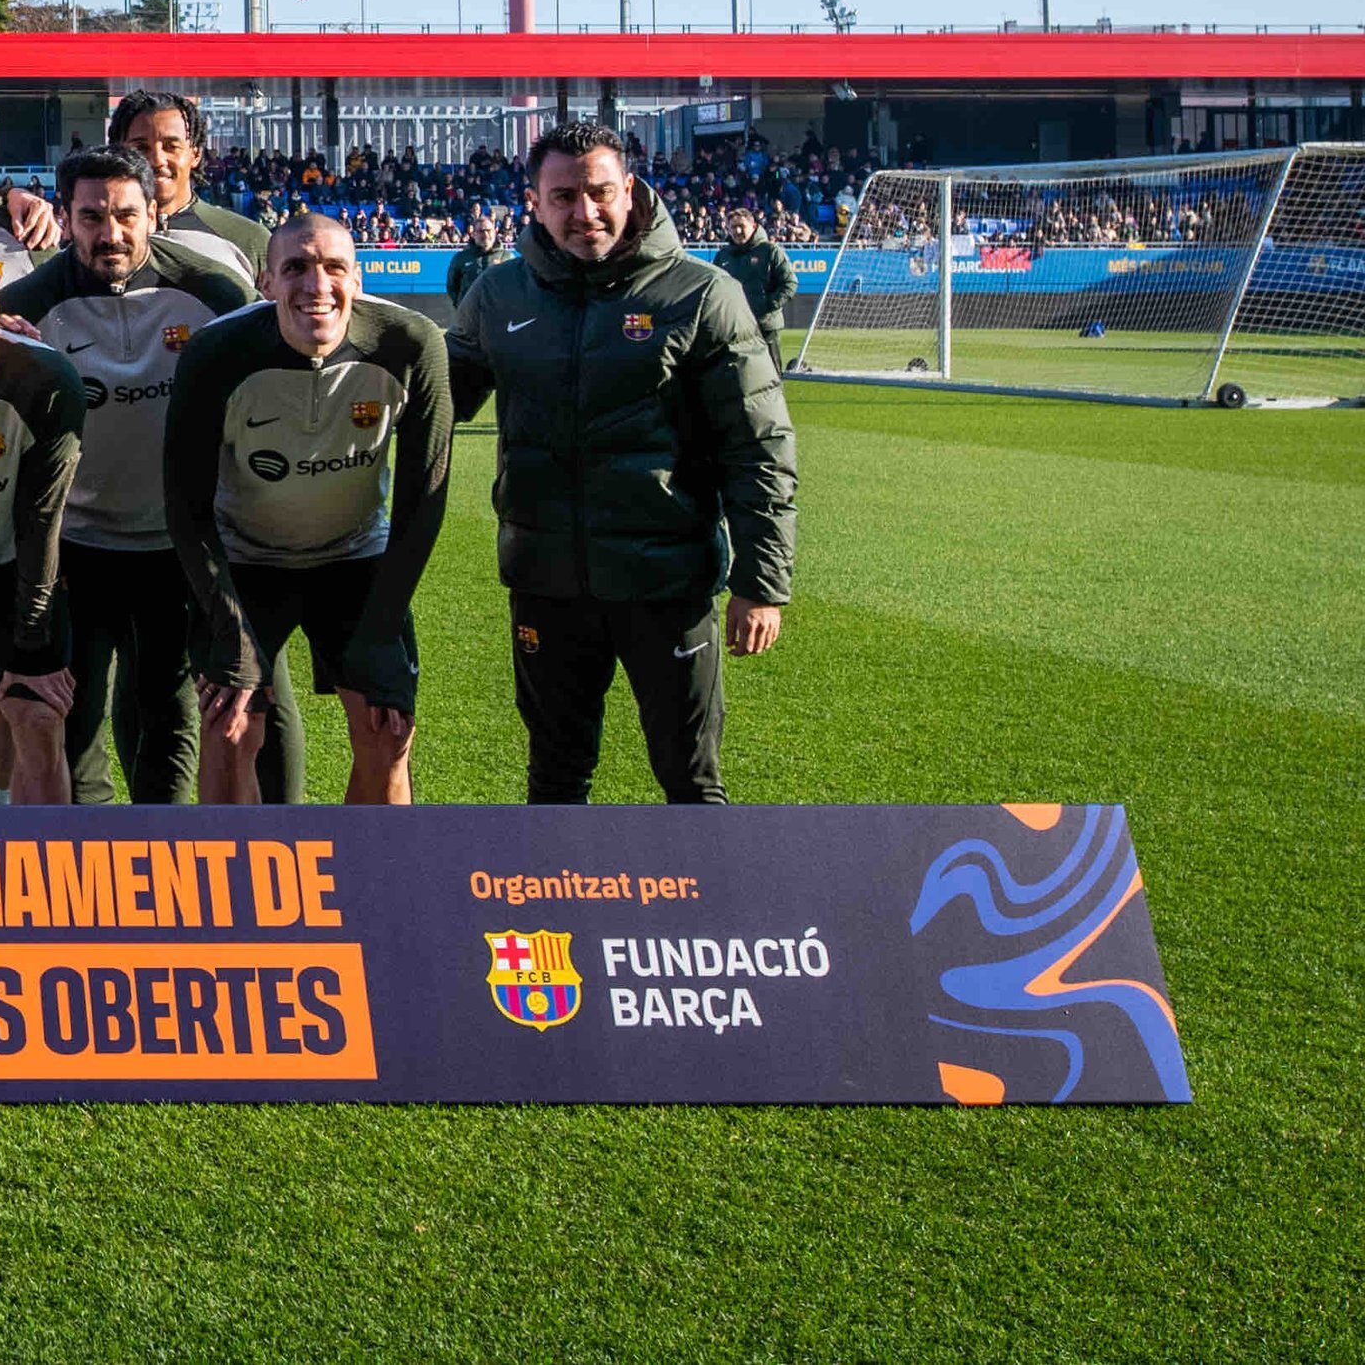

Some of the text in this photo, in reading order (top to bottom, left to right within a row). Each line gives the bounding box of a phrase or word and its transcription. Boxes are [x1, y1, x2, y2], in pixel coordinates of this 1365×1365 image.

[387, 261, 421, 273] CLUB
[792, 260, 827, 273] CLUB
[114, 377, 173, 404] Spoti
[296, 450, 378, 475] Spotify
[249, 840, 342, 928] DE
[470, 869, 700, 905] Organitzat per:
[602, 927, 830, 977] FUNDACIÓ
[516, 971, 552, 983] FCB
[39, 966, 347, 1056] OBERTES
[610, 988, 763, 1035] BARÇA
